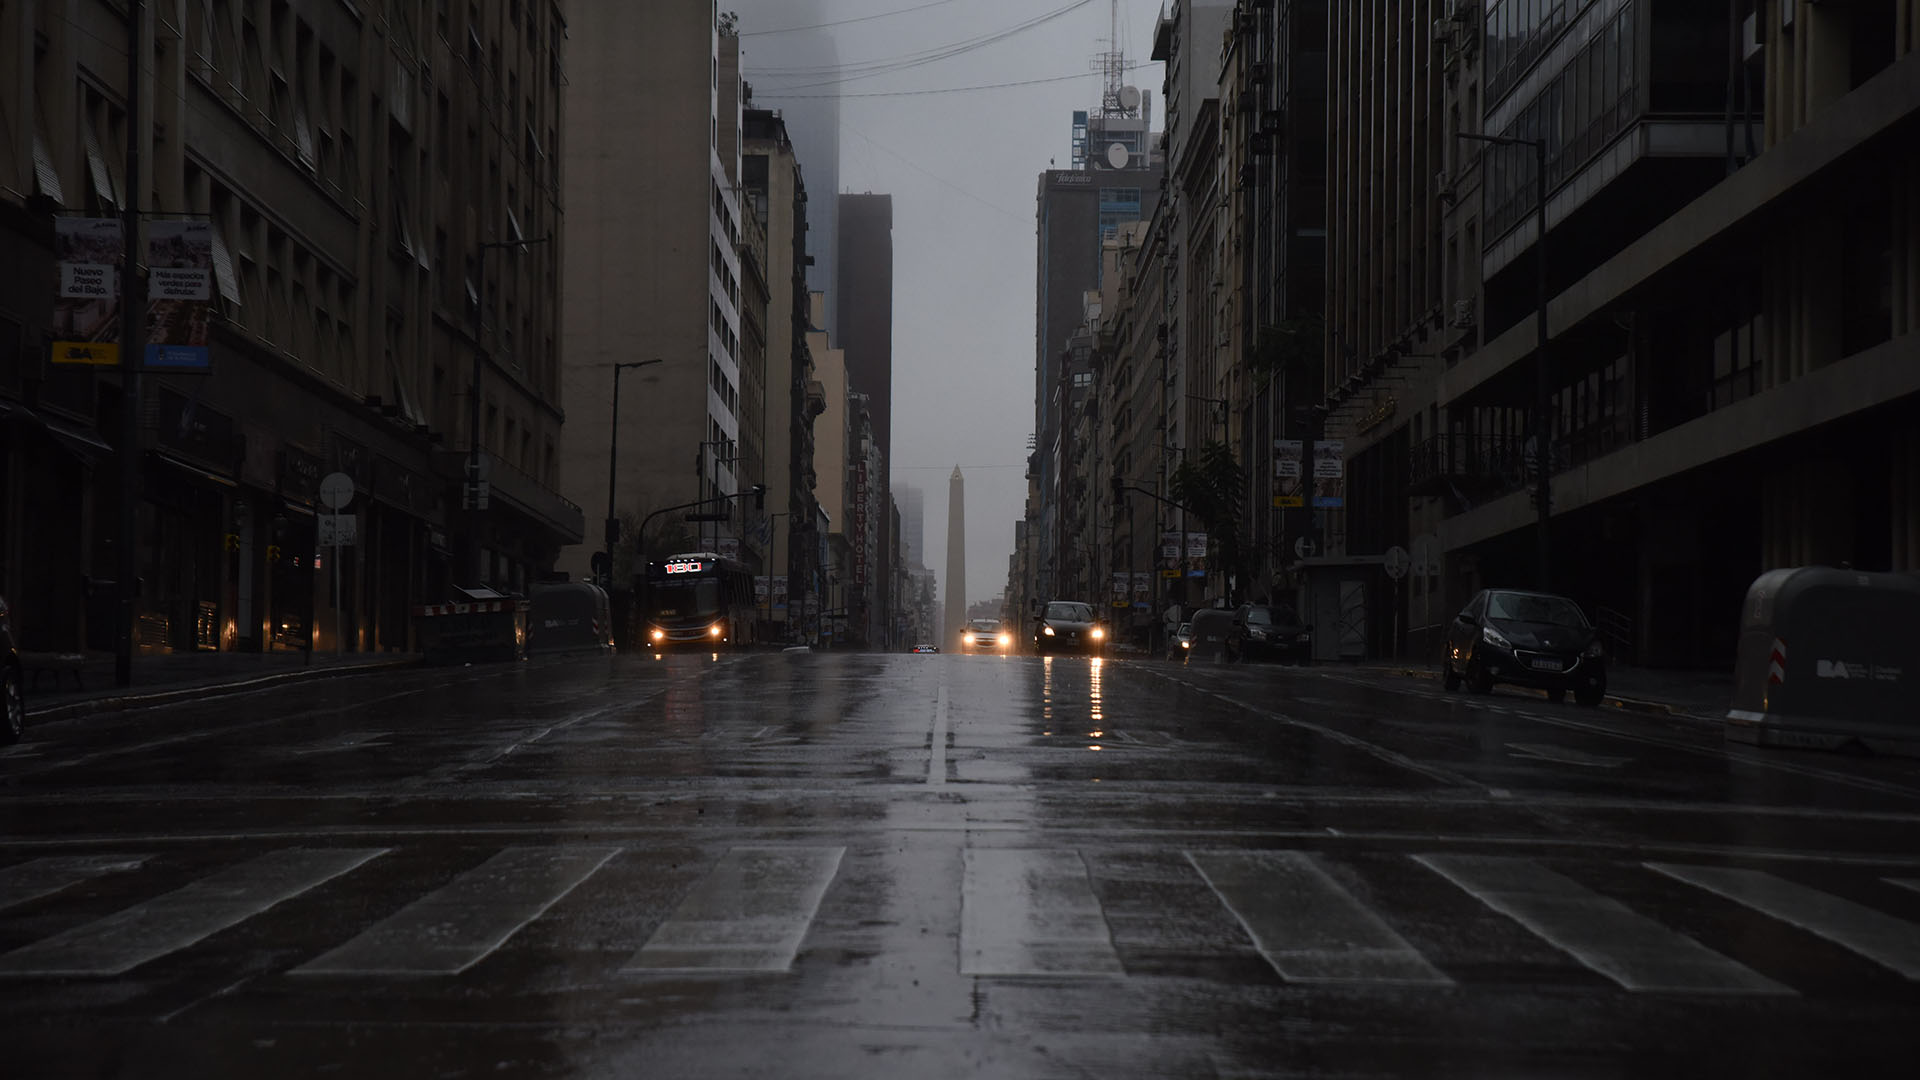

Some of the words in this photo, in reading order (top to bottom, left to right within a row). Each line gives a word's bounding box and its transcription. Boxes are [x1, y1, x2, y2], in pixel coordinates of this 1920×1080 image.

[73, 267, 103, 276] Nuevo
[74, 276, 102, 285] Paseo
[172, 273, 204, 281] espacios
[185, 281, 202, 289] para
[68, 285, 83, 293] del
[85, 286, 107, 295] Bajo.
[856, 463, 865, 531] LIBERTY
[855, 535, 864, 584] HOTEL
[664, 562, 702, 574] 180
